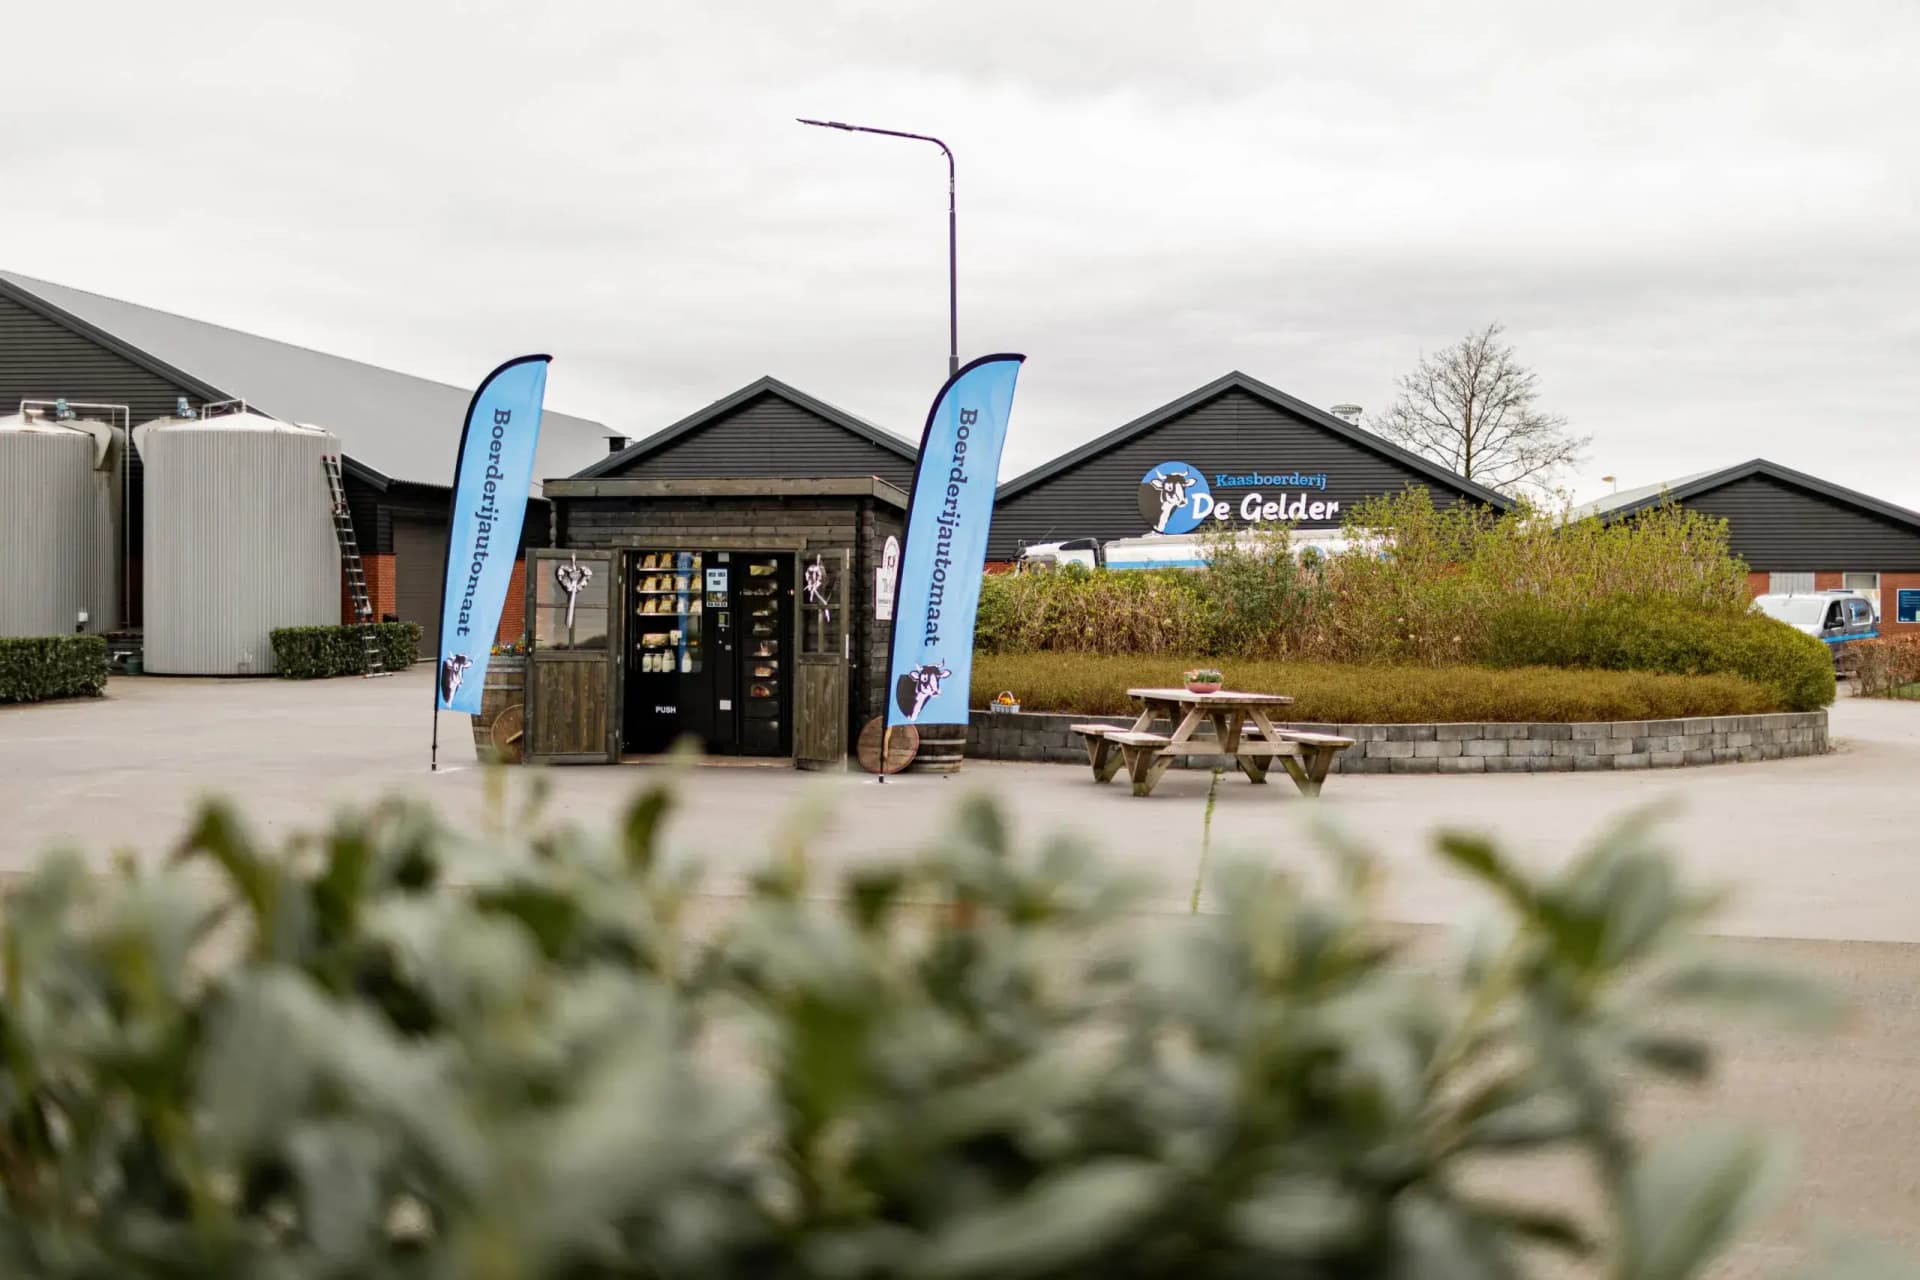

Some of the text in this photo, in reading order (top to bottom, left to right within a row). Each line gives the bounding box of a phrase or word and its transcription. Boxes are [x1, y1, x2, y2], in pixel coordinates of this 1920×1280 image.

[1215, 472, 1328, 491] Kaasboerderij
[1191, 492, 1339, 522] De Gelder
[457, 408, 511, 637] Boerderijautomaat
[925, 407, 978, 647] Boerderijautomaat
[655, 705, 677, 714] PUSH
